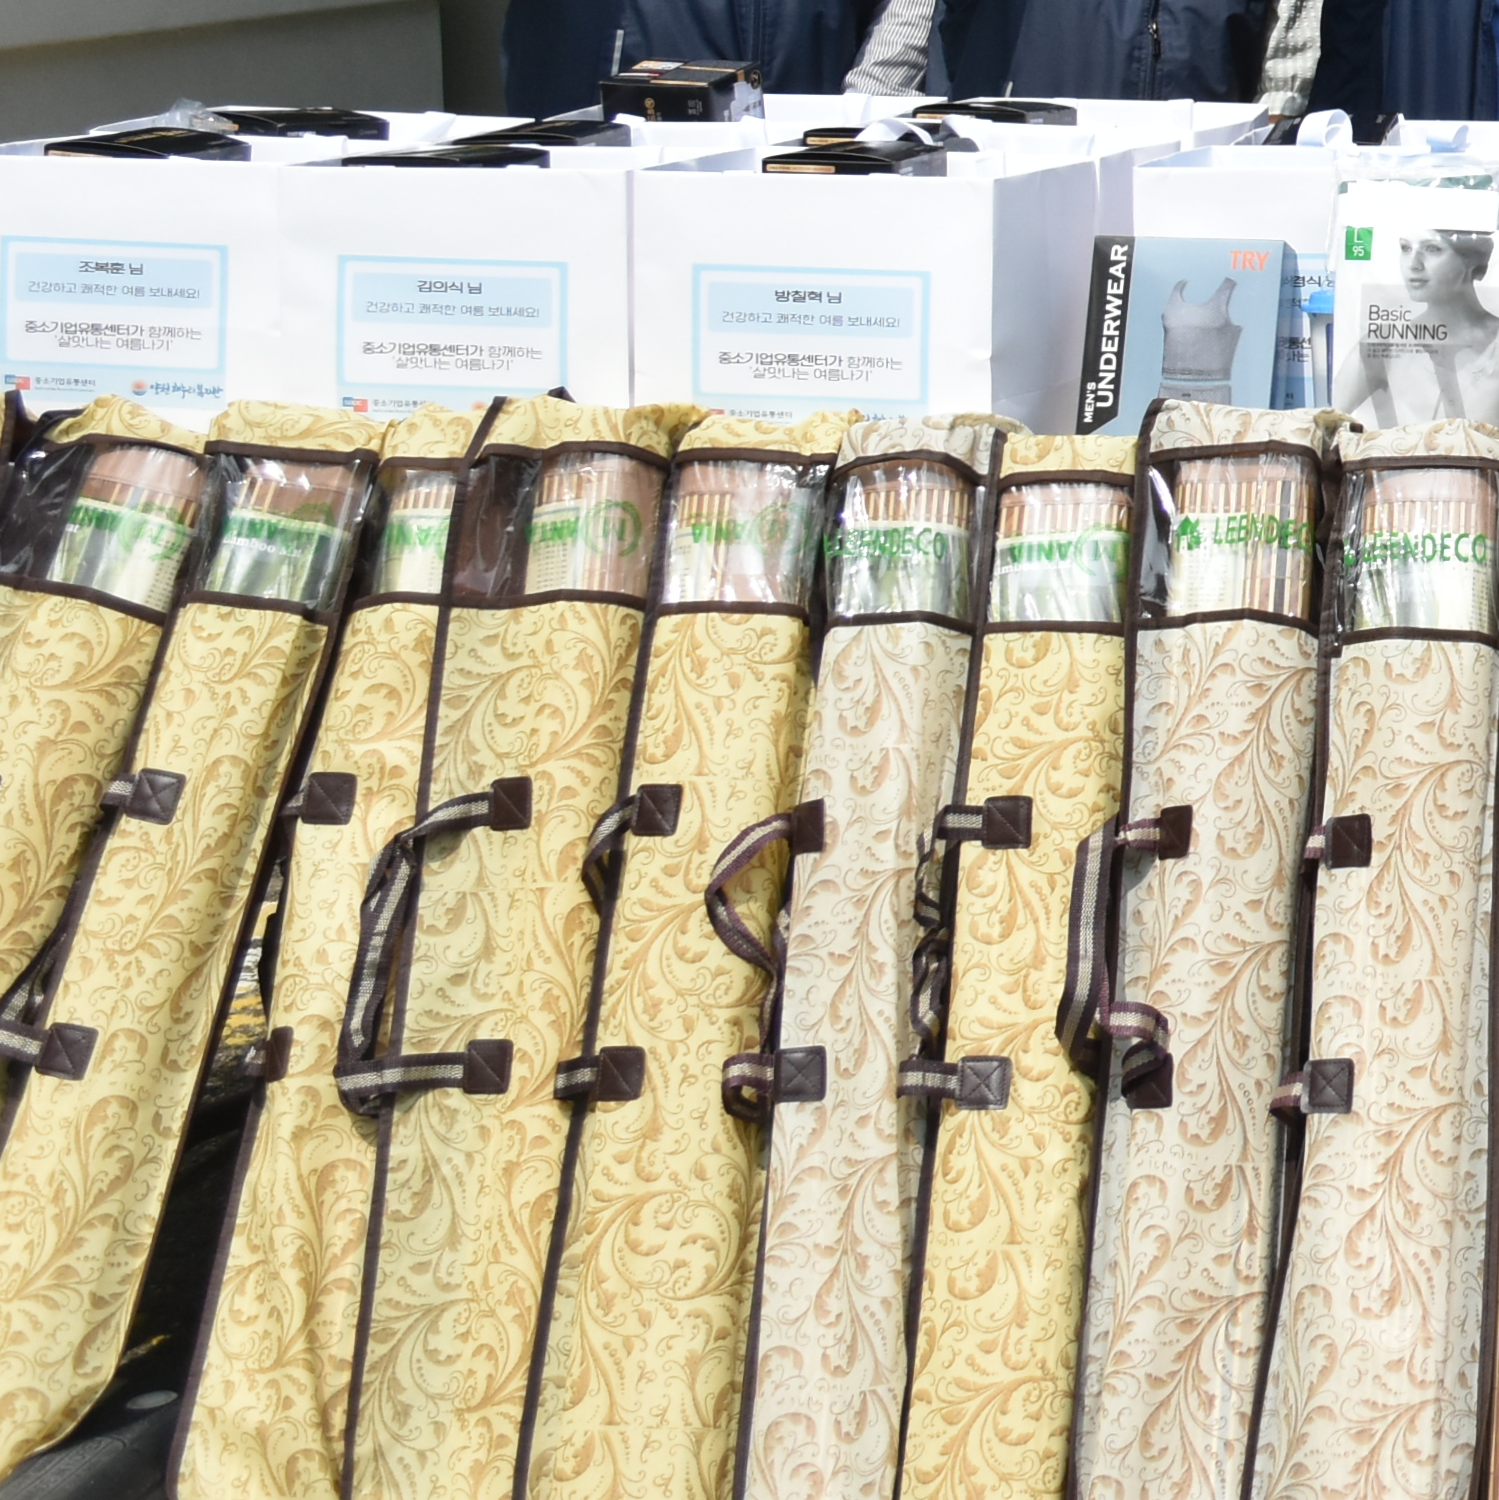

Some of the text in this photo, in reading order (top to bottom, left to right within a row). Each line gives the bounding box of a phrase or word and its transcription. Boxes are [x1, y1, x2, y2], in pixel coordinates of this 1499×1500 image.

[1354, 228, 1364, 243] L
[1352, 246, 1364, 257] 95
[129, 262, 144, 275] 님
[1229, 250, 1271, 271] TRY
[28, 281, 200, 298] 건강하고 쾌적한 여름 보내세요!
[467, 282, 482, 294] 님
[827, 292, 842, 304] 님
[366, 302, 539, 318] 건강하고 쾌적한 여름 보내세요!
[1368, 304, 1412, 322] Basic
[722, 311, 900, 328] 건강하고 쾌적한 여름 보내세요!
[1096, 244, 1129, 408] UNDERWEAR
[25, 321, 202, 340] 중소기업유통센터가 함께하는
[1367, 323, 1448, 341] RUNNING
[362, 342, 542, 359] 중소기업유통센터가 함께하는
[718, 352, 902, 370] 중소기업유통센터가 함께하는
[1083, 382, 1097, 423] MEN'S
